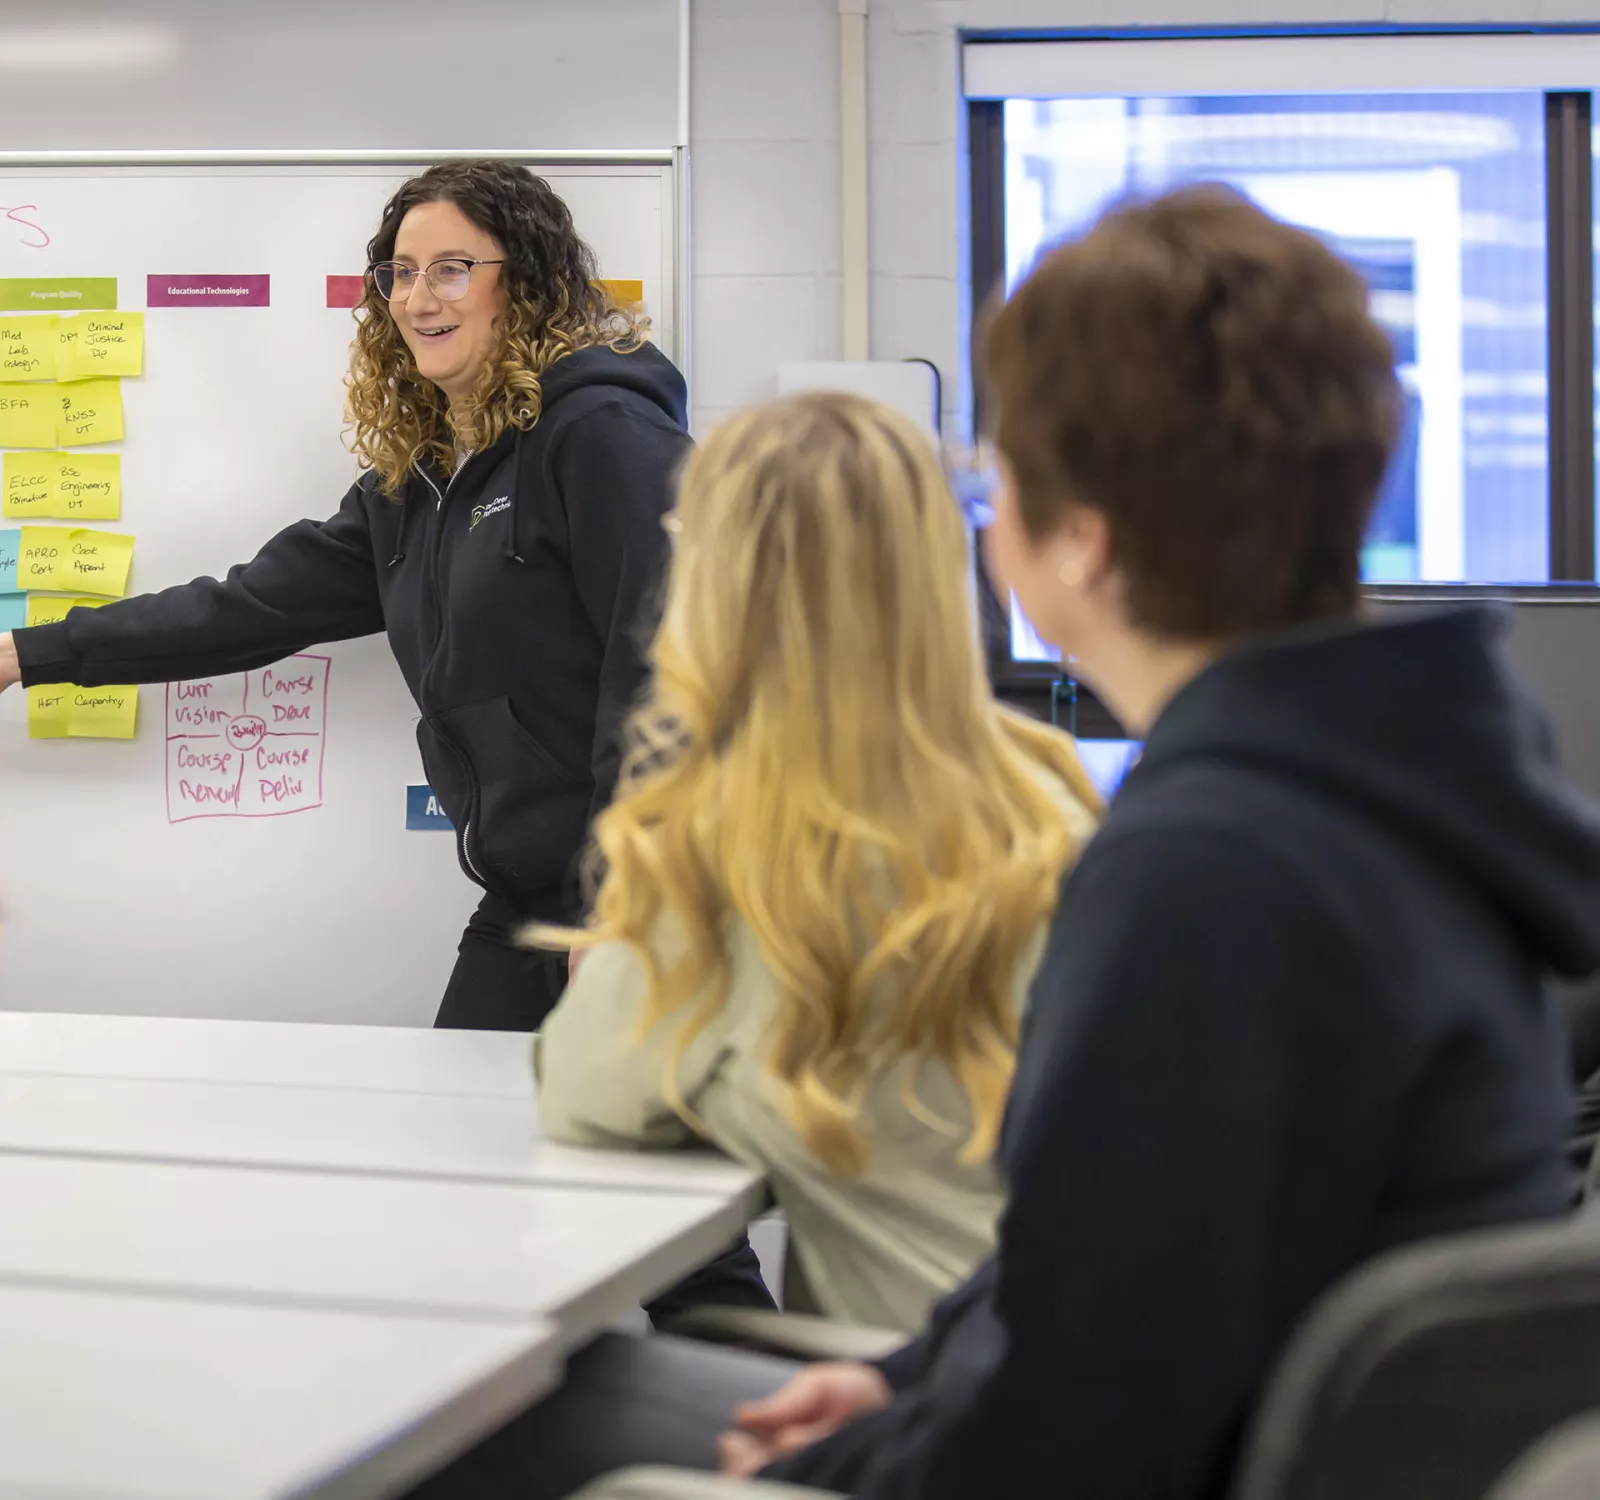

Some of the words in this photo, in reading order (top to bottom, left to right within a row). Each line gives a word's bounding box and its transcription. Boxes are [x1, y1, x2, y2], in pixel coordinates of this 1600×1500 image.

[31, 291, 58, 300] Program
[59, 290, 82, 299] Quality
[167, 287, 206, 295] Educational
[207, 286, 249, 296] Technologies
[87, 322, 124, 332] Criminal
[1, 330, 22, 341] Med
[85, 334, 126, 346] Justice
[0, 398, 29, 410] BFA
[60, 481, 111, 496] Engineering
[262, 669, 314, 698] Course
[74, 694, 125, 710] Carpentry
[178, 744, 232, 774] Course
[257, 746, 310, 770] Course
